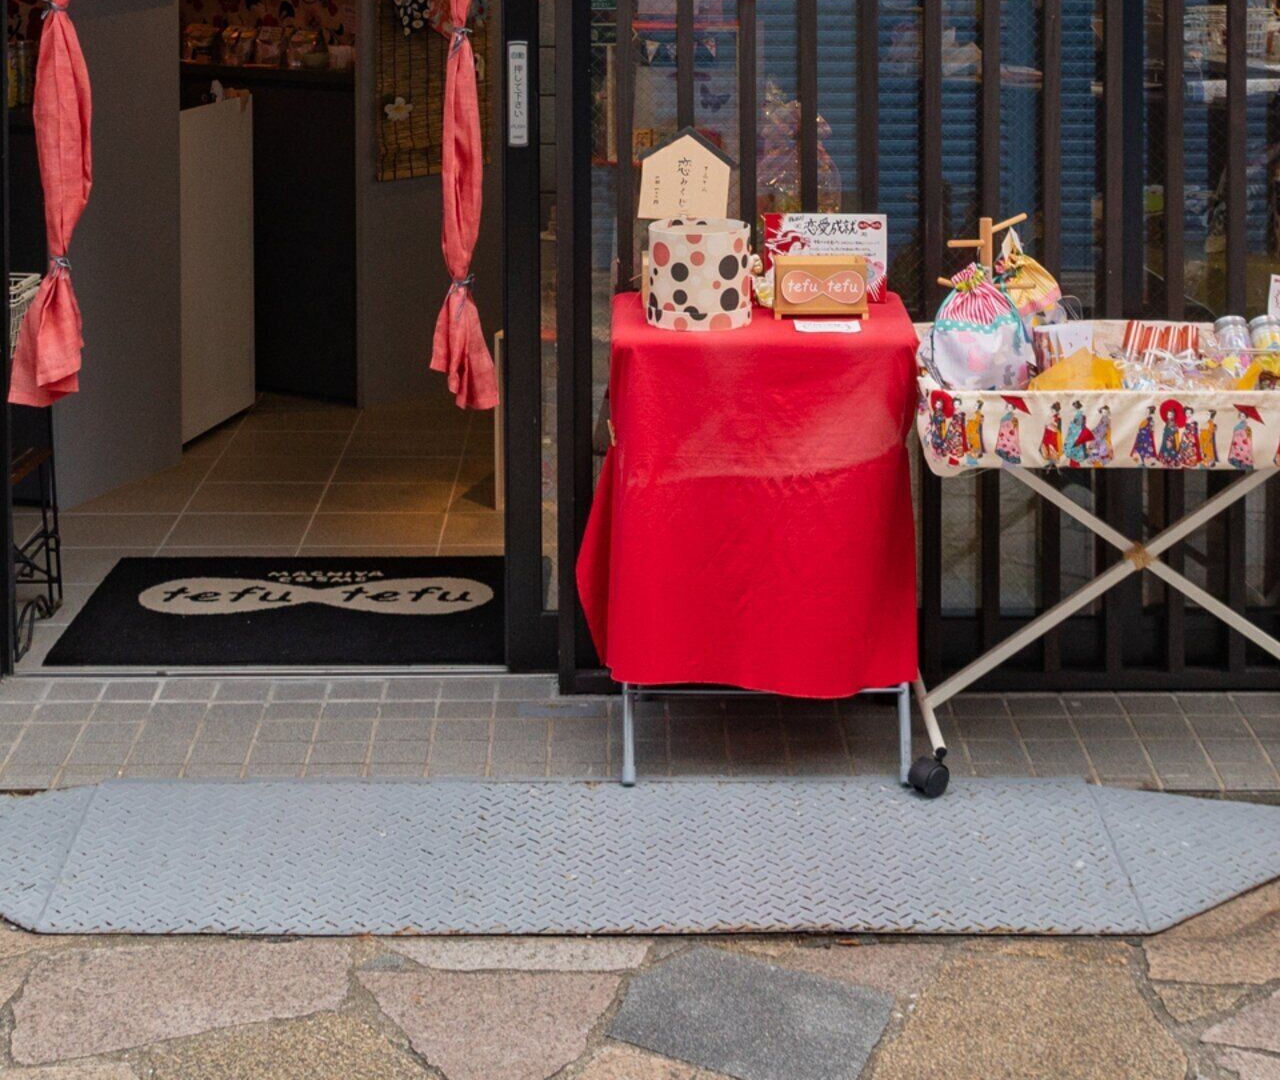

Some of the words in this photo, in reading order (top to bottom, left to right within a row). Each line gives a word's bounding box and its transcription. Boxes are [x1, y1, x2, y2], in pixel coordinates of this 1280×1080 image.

[514, 64, 524, 117] 押して下さい
[804, 217, 857, 236] 恋愛成就
[787, 279, 818, 293] tefu
[827, 279, 858, 293] tefu
[163, 585, 293, 603] tefu
[342, 585, 473, 603] tefu
